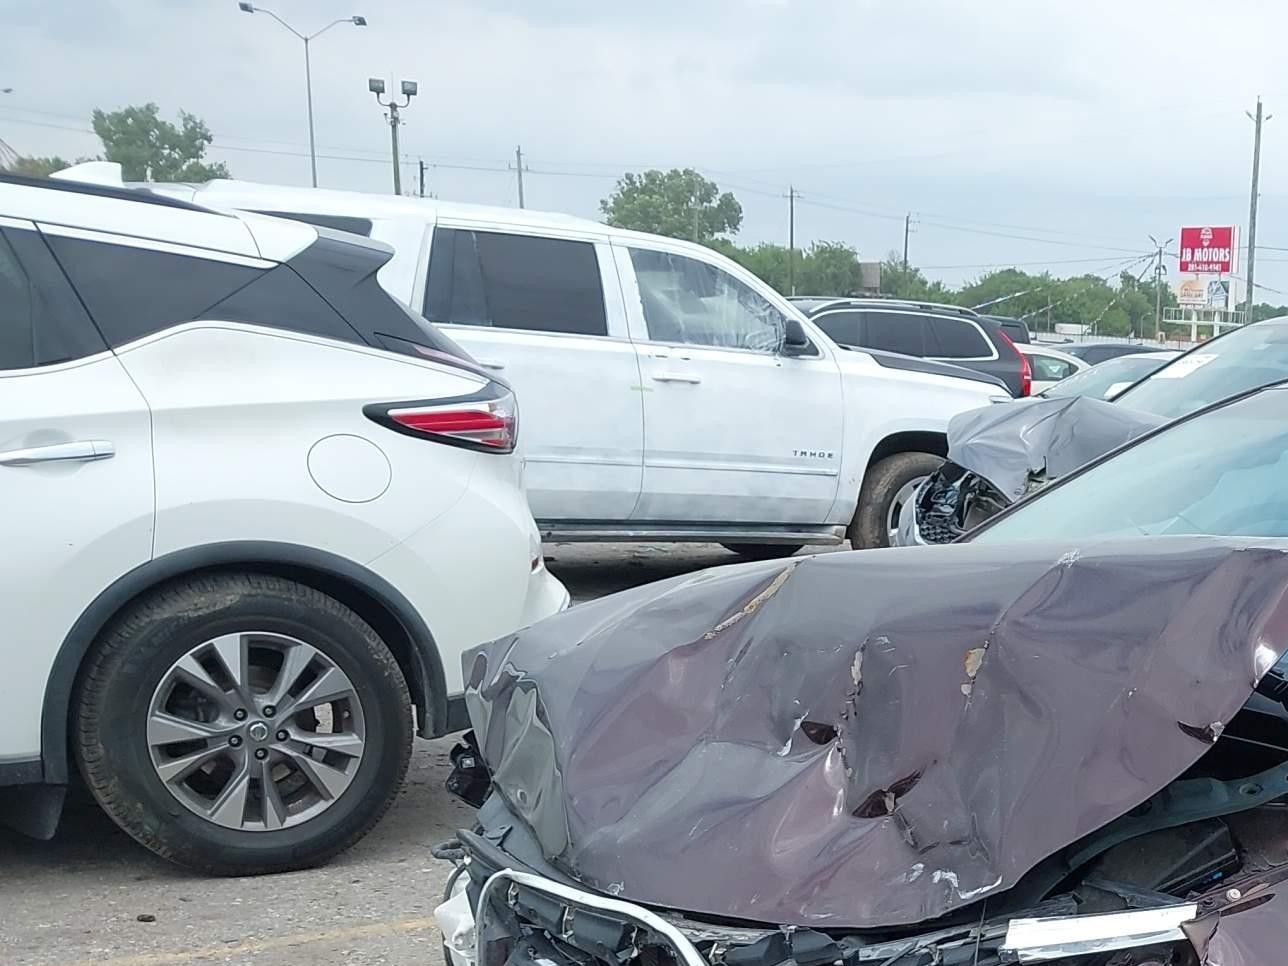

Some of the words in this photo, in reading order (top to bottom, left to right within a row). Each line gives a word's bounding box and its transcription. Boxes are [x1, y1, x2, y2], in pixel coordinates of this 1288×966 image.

[1182, 247, 1192, 262] JB
[1193, 247, 1230, 262] MOTORS
[792, 450, 834, 459] TAHOE
